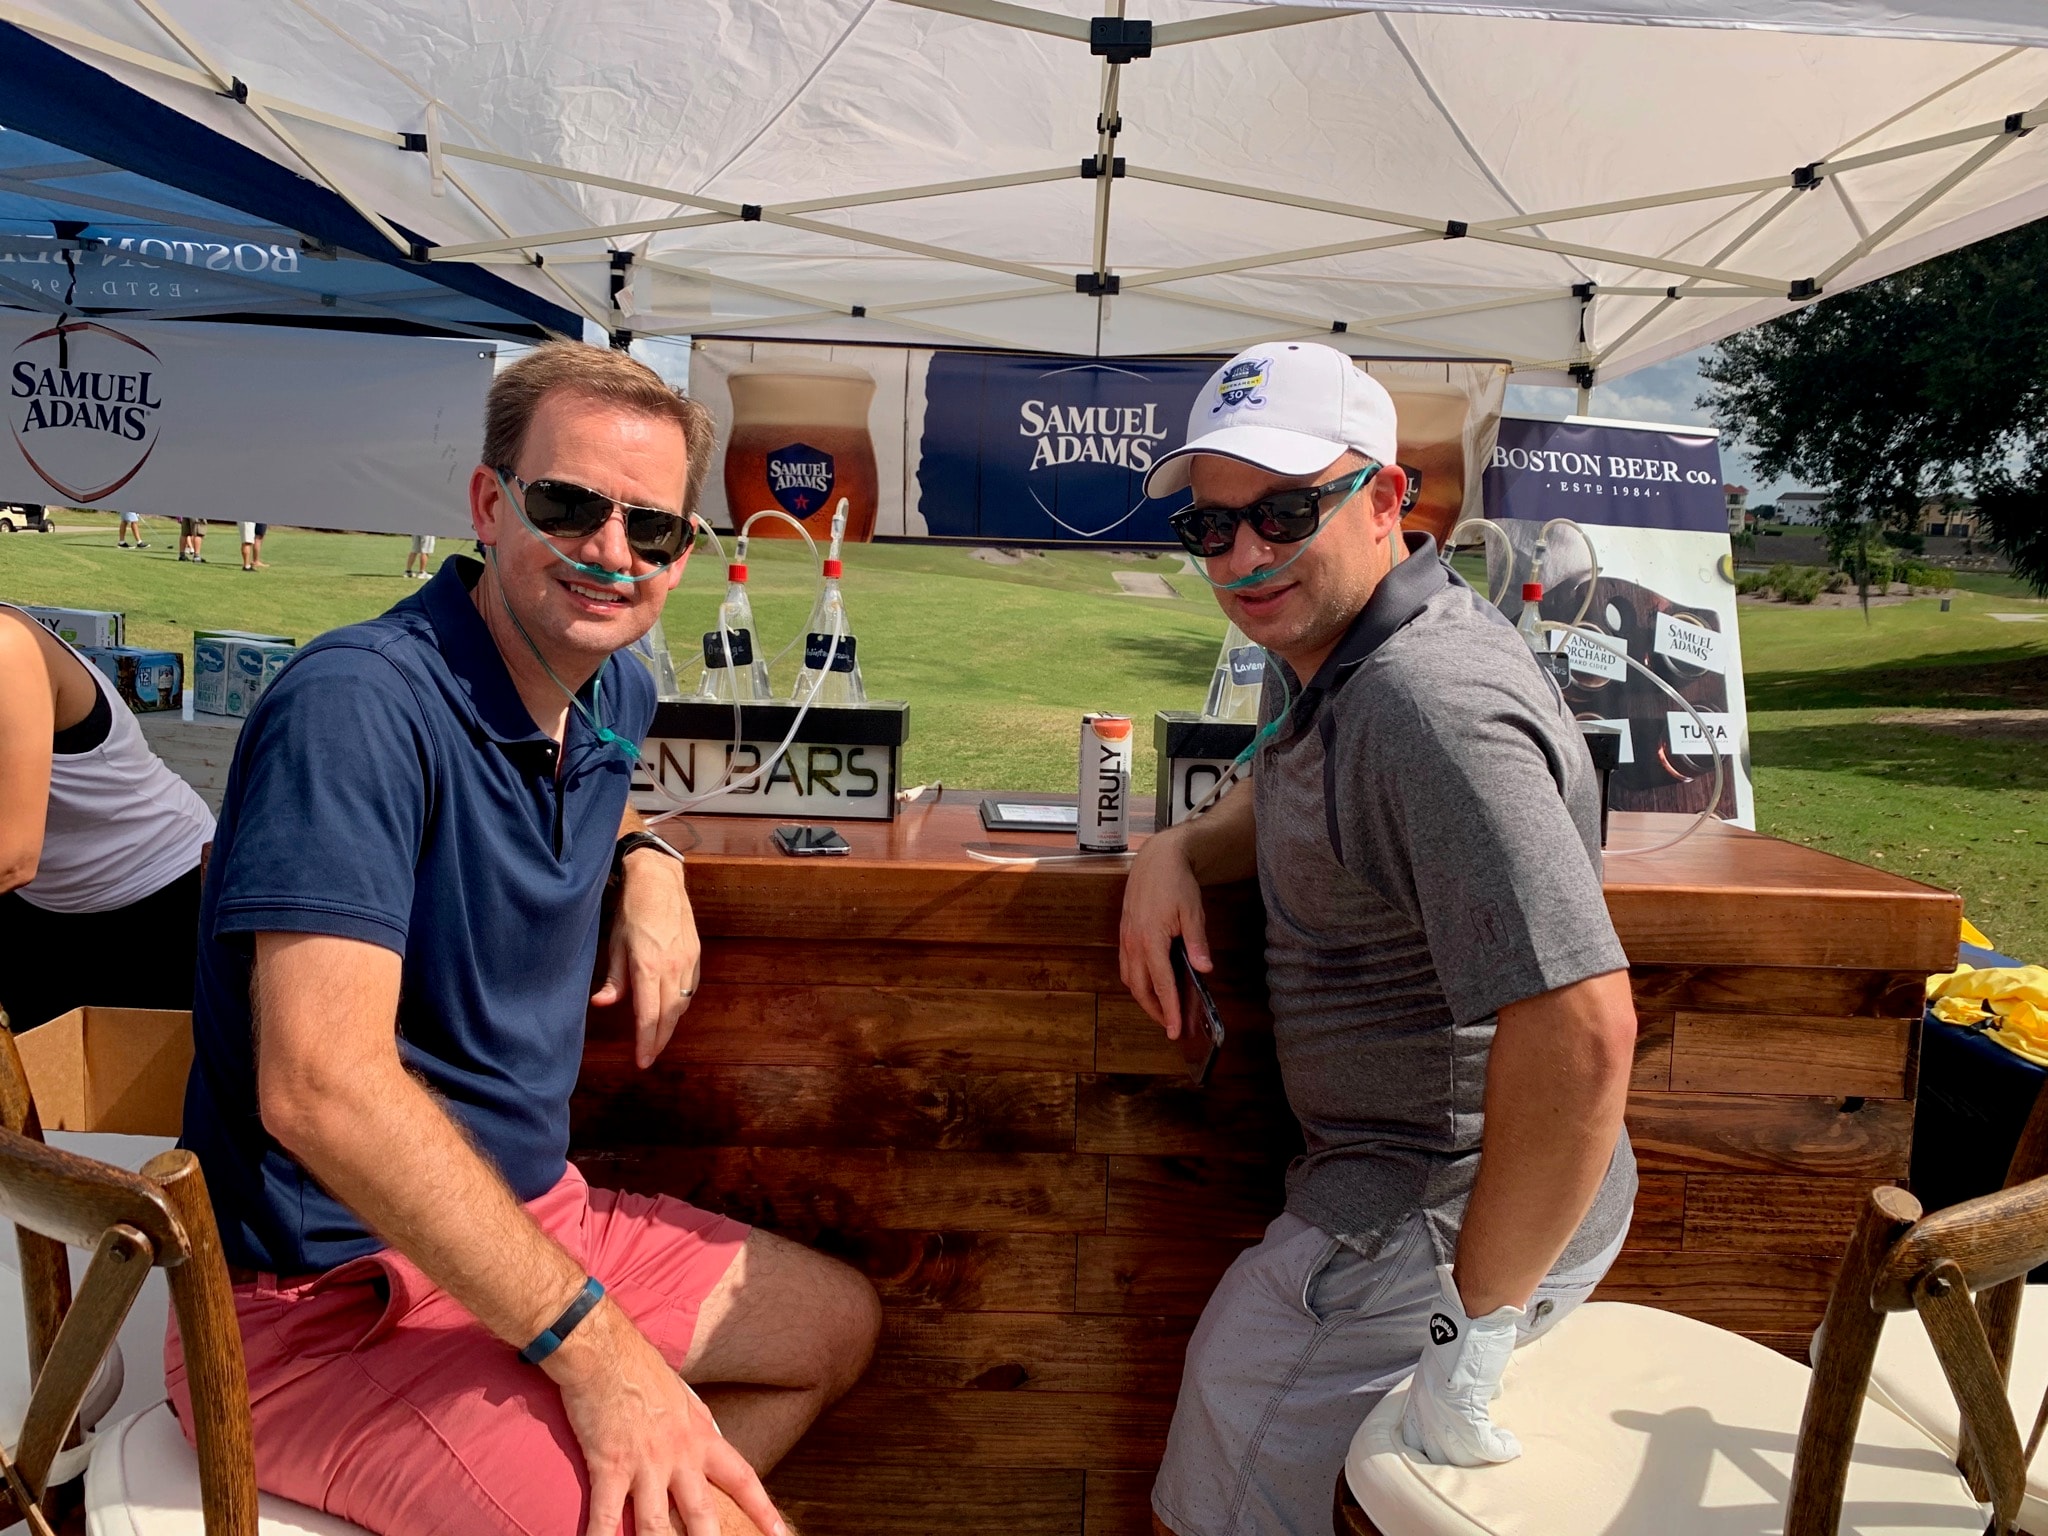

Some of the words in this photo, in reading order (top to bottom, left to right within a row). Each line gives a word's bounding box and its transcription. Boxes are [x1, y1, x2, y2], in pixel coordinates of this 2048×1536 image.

[12, 361, 161, 409] SAMUEL
[1228, 390, 1243, 400] 30
[22, 399, 146, 441] ADAMS
[1020, 400, 1167, 440] SAMUEL
[1029, 435, 1153, 473] ADAMS
[1491, 446, 1602, 477] BOSTON
[1608, 456, 1682, 483] BEER
[770, 460, 832, 478] SAMUEL
[775, 475, 828, 492] ADAMS
[1571, 636, 1606, 652] ANG
[1668, 624, 1713, 651] SAMUEL
[1670, 638, 1708, 661] ADAMS
[1234, 662, 1265, 673] Laven
[1589, 663, 1607, 671] CIDER
[725, 744, 878, 797] BARS
[1097, 744, 1121, 826] TRULY
